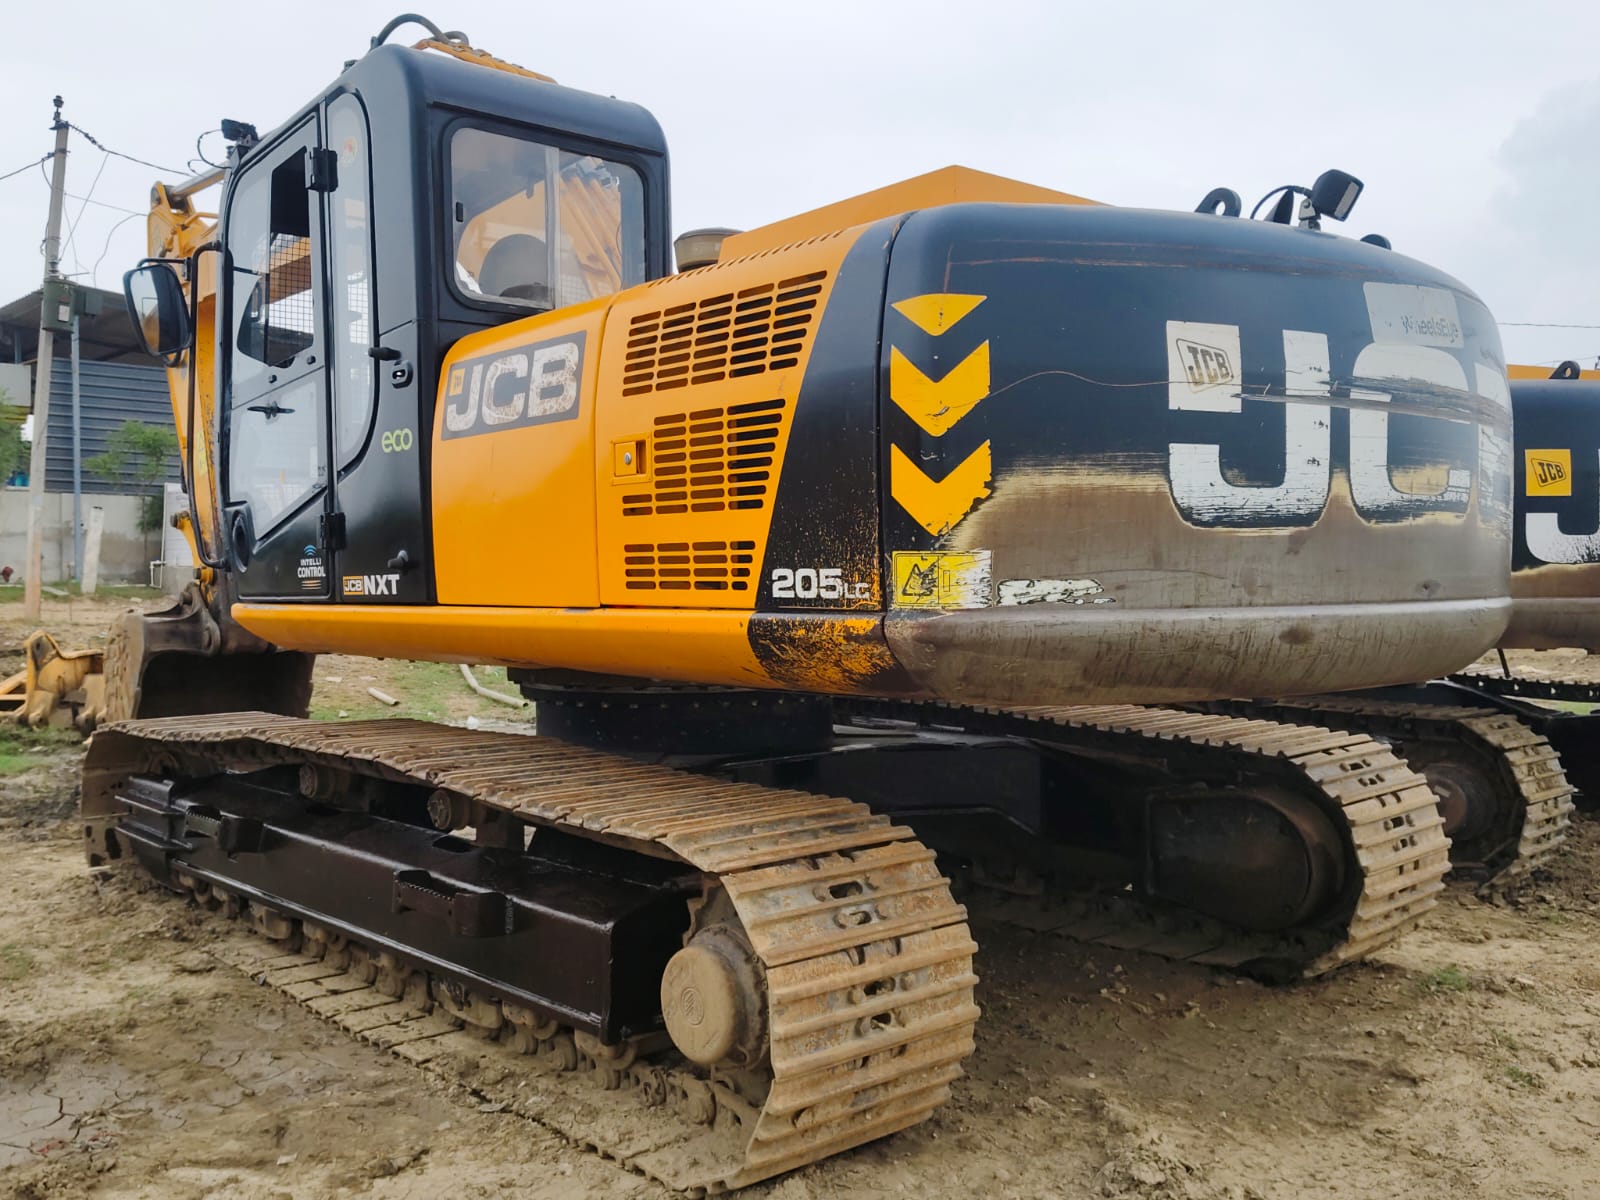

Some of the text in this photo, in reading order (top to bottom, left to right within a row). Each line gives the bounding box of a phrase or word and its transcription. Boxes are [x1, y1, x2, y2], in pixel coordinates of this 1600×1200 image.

[1186, 345, 1230, 387] JCB
[446, 342, 579, 432] JCB
[381, 428, 413, 454] eco
[1538, 462, 1564, 484] JCB
[297, 566, 326, 578] CONTROL
[300, 558, 322, 566] INTELLI
[344, 574, 400, 595] JCB NXT
